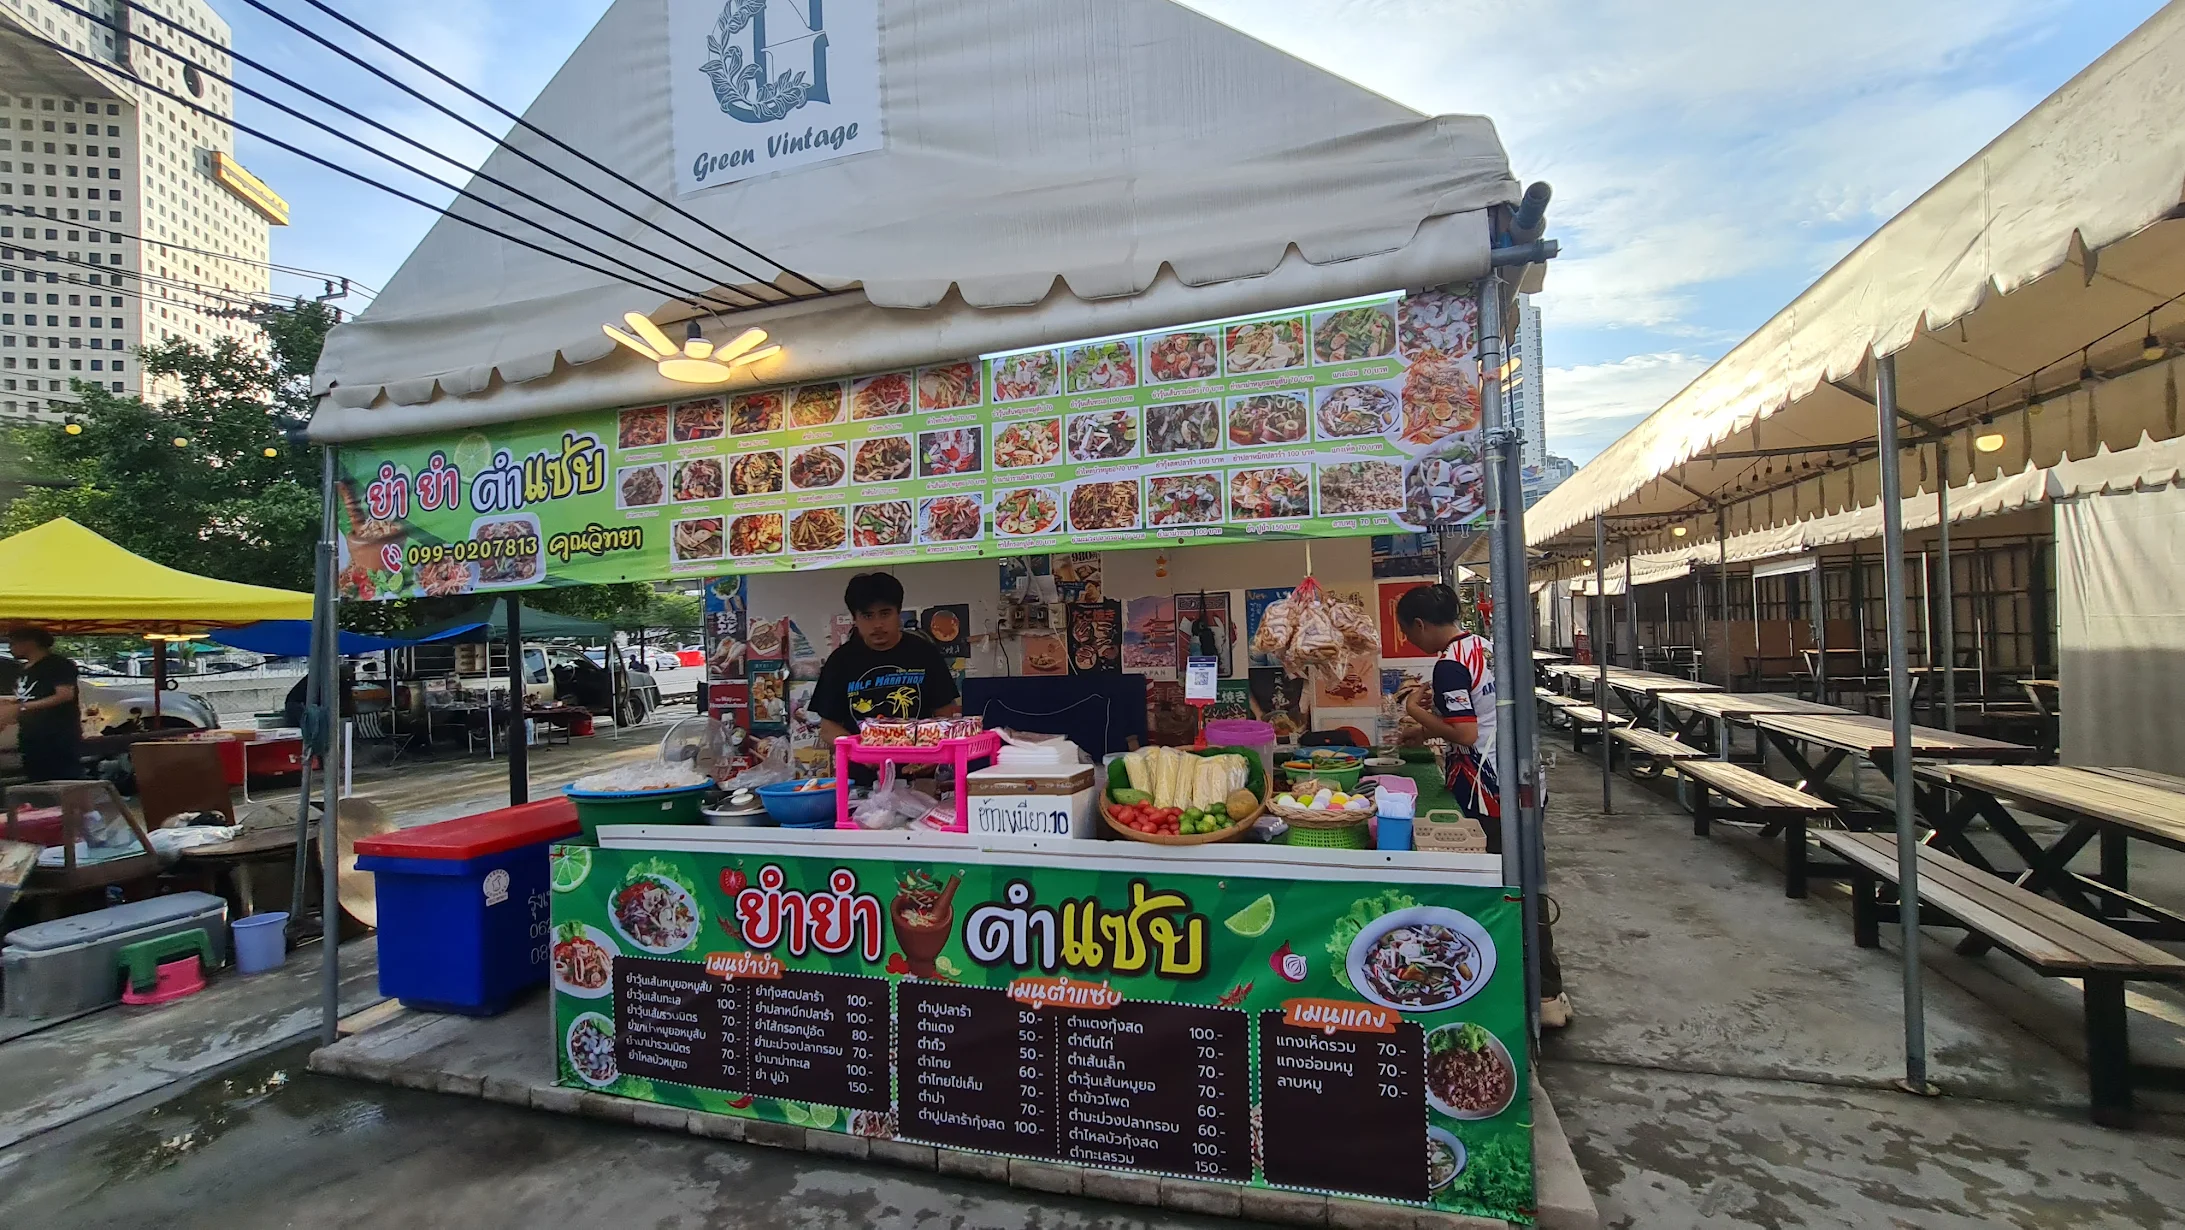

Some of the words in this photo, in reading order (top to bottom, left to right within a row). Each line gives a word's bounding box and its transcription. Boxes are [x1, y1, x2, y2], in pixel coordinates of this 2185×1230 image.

[693, 148, 755, 182] Green
[767, 122, 859, 158] Vintage
[366, 460, 408, 520] ยำ
[416, 450, 460, 512] ยำ
[407, 536, 538, 566] 099-0207813
[549, 523, 642, 563] คุณวิทยา
[847, 679, 872, 692] HALF
[736, 864, 882, 962] ยำยำ
[706, 951, 779, 981] เมนูยำยำ
[720, 983, 742, 994] 70.-
[755, 984, 824, 1003] ยำกุ้งสดปลาร้า
[846, 995, 873, 1007] 100.-
[1006, 976, 1122, 1010] เมนูตำแซ่บ
[717, 998, 742, 1010] 100.-
[755, 1001, 834, 1022] ยำปลาหมึกปลาร้า
[846, 1013, 874, 1024] 100.-
[917, 1000, 972, 1018] ตำปูปลาร้า
[1018, 1012, 1043, 1025] 50.-
[722, 1015, 742, 1027] 70.-
[754, 1018, 825, 1039] ยำไส้กรอกปูอัด
[852, 1030, 874, 1042] 80.-
[917, 1018, 955, 1034] ตำแตง
[1018, 1030, 1043, 1042] 50.-
[1067, 1015, 1144, 1035] ตำแตงกุ้งสด
[1189, 1027, 1224, 1041] 100.-
[1294, 1003, 1386, 1035] เมนูแกง
[721, 1032, 741, 1043] 70.-
[754, 1035, 843, 1056] ยำมะม่วงปลากรอบ
[852, 1047, 873, 1059] 70.-
[1067, 1032, 1114, 1051] ตำตีนไก่
[1197, 1046, 1224, 1060] 70.-
[1276, 1035, 1356, 1054] แกงเห็ดรวม
[1376, 1042, 1407, 1057] 70.-
[721, 1049, 741, 1060] 70.-
[754, 1052, 811, 1070] ยำมาม่าทะเล
[846, 1064, 873, 1077] 100.-
[917, 1054, 951, 1069] ตำไทย
[1018, 1066, 1044, 1079] 60.-
[1019, 1048, 1044, 1060] 50.-
[1067, 1051, 1126, 1071] ตำเส้นเล็ก
[1197, 1065, 1225, 1079] 70.-
[1276, 1055, 1354, 1077] แกงอ่อมหมู
[1377, 1063, 1408, 1078] 70.-
[722, 1065, 742, 1076] 70.-
[755, 1068, 766, 1080] ยำ
[848, 1081, 874, 1094] 150.-
[918, 1071, 983, 1091] ตำไทยไข่เค็ม
[1019, 1084, 1044, 1098] 70.-
[1067, 1070, 1156, 1095] ตำวุ้นเส้นหมูยอ
[1198, 1085, 1225, 1099] 70.-
[1277, 1076, 1323, 1094] ลาบหมู
[1378, 1083, 1408, 1098] 70.-
[1020, 1103, 1045, 1116] 70.-
[1068, 1089, 1130, 1108] ตำข้าวโพด
[1197, 1105, 1225, 1119] 60.-
[918, 1107, 1006, 1131] ตำปูปลาร้ากุ้งสด
[1014, 1121, 1045, 1135] 100.-
[1068, 1107, 1180, 1134] ตำมะม่วงปลากรอบ
[1198, 1124, 1226, 1138] 60.-
[1068, 1126, 1159, 1150] ตำไหลบัวกุ้งสด
[1192, 1142, 1227, 1157] 100.-
[1069, 1145, 1135, 1165] ตำทะเลรวม
[1194, 1161, 1228, 1174] 150.-
